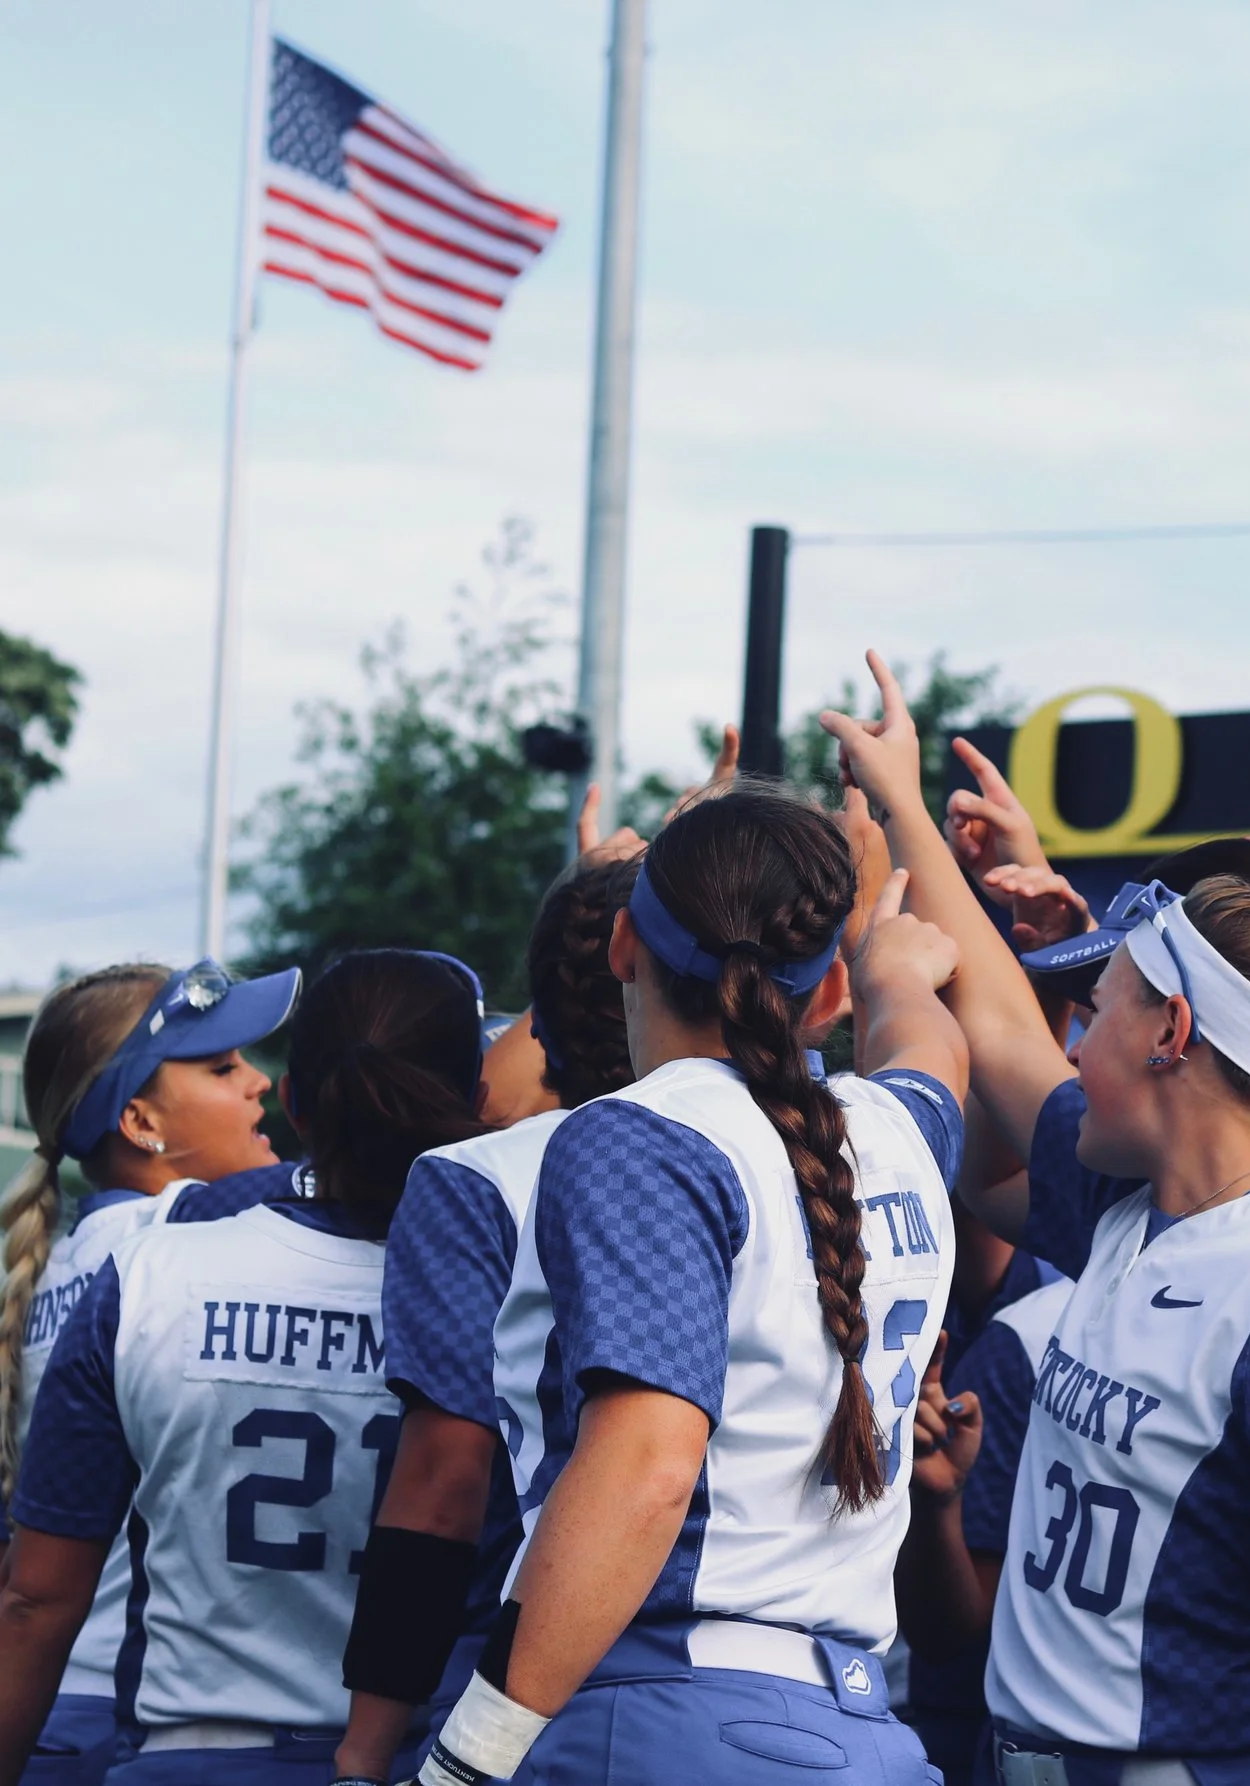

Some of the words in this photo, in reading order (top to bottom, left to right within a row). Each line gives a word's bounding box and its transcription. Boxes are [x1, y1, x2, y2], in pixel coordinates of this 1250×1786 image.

[1009, 686, 1182, 856] O
[1050, 938, 1117, 965] SOFTBALL
[200, 1301, 386, 1373] HUFFM
[227, 1408, 399, 1575] 21
[1023, 1459, 1141, 1617] 30
[444, 1759, 475, 1782] KENTUCKY
